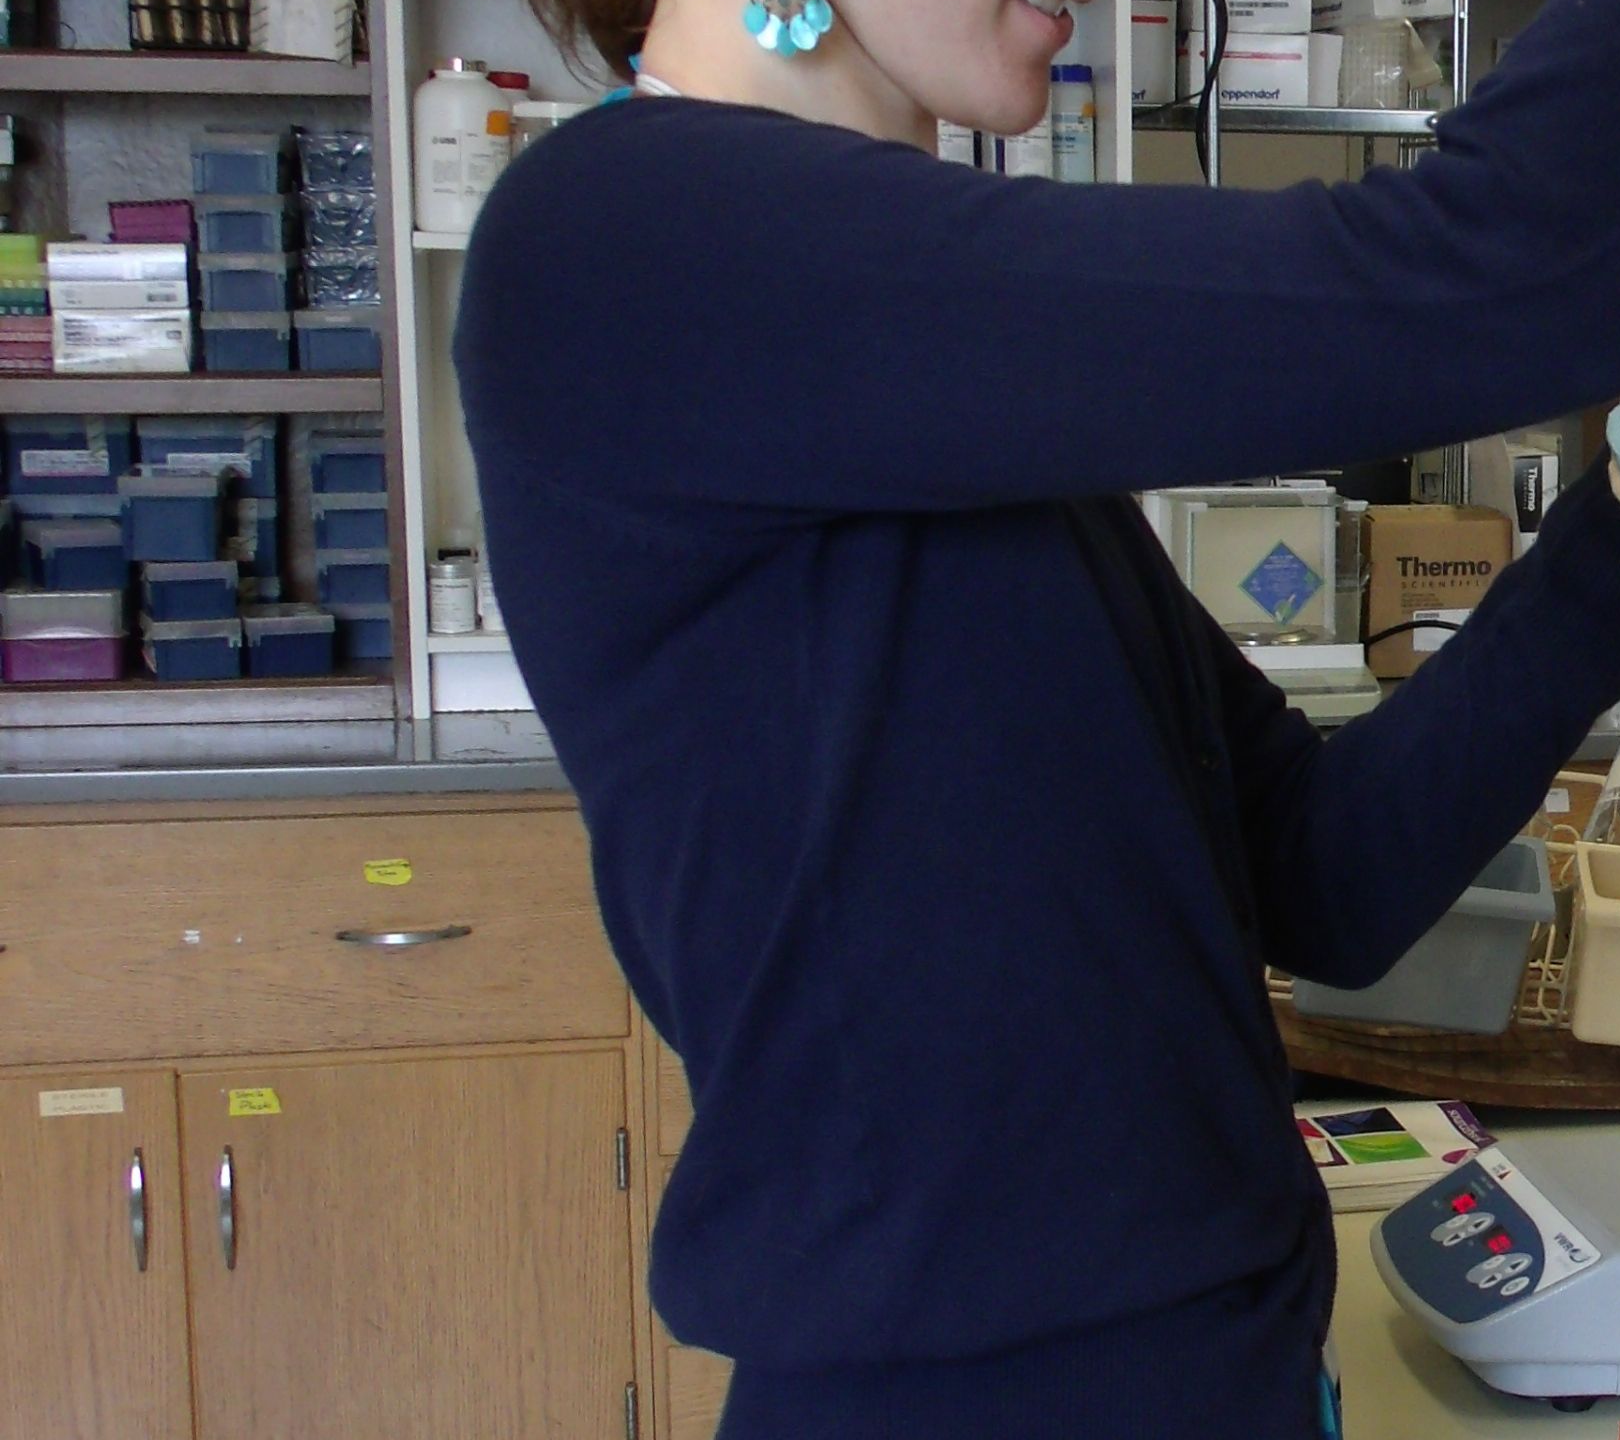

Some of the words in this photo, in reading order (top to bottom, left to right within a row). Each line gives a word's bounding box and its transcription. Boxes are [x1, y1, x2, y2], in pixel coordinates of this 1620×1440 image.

[1221, 88, 1280, 102] eppendorf
[1527, 466, 1539, 512] Thermo
[1396, 556, 1492, 577] Thermo
